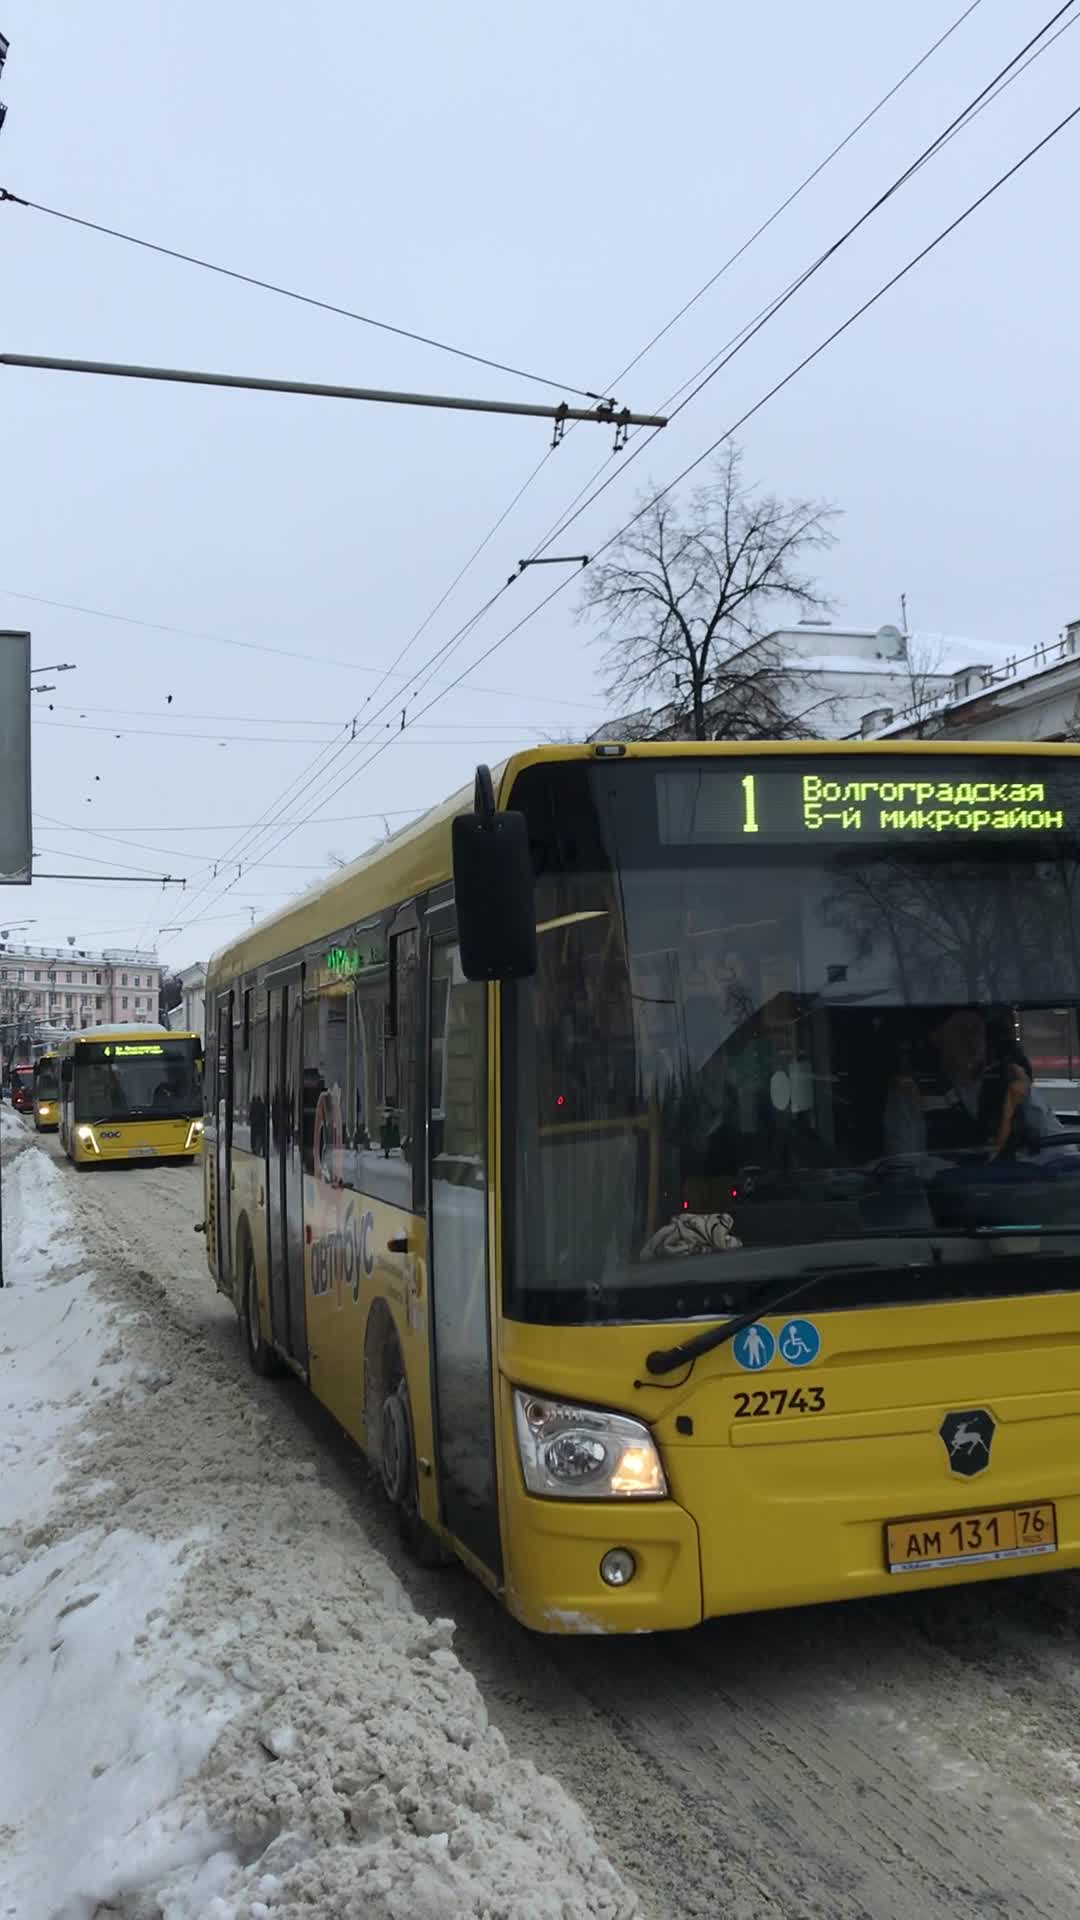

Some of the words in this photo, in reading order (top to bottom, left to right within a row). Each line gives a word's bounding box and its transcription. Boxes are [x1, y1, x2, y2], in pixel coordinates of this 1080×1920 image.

[742, 775, 759, 832] 1
[803, 776, 1045, 805] Волгоградская
[804, 804, 861, 830] 5-й
[880, 807, 1064, 832] микрорайон
[733, 1387, 826, 1418] 22743
[906, 1532, 943, 1558] АМ
[950, 1517, 1001, 1551] 131
[1018, 1510, 1046, 1534] 76
